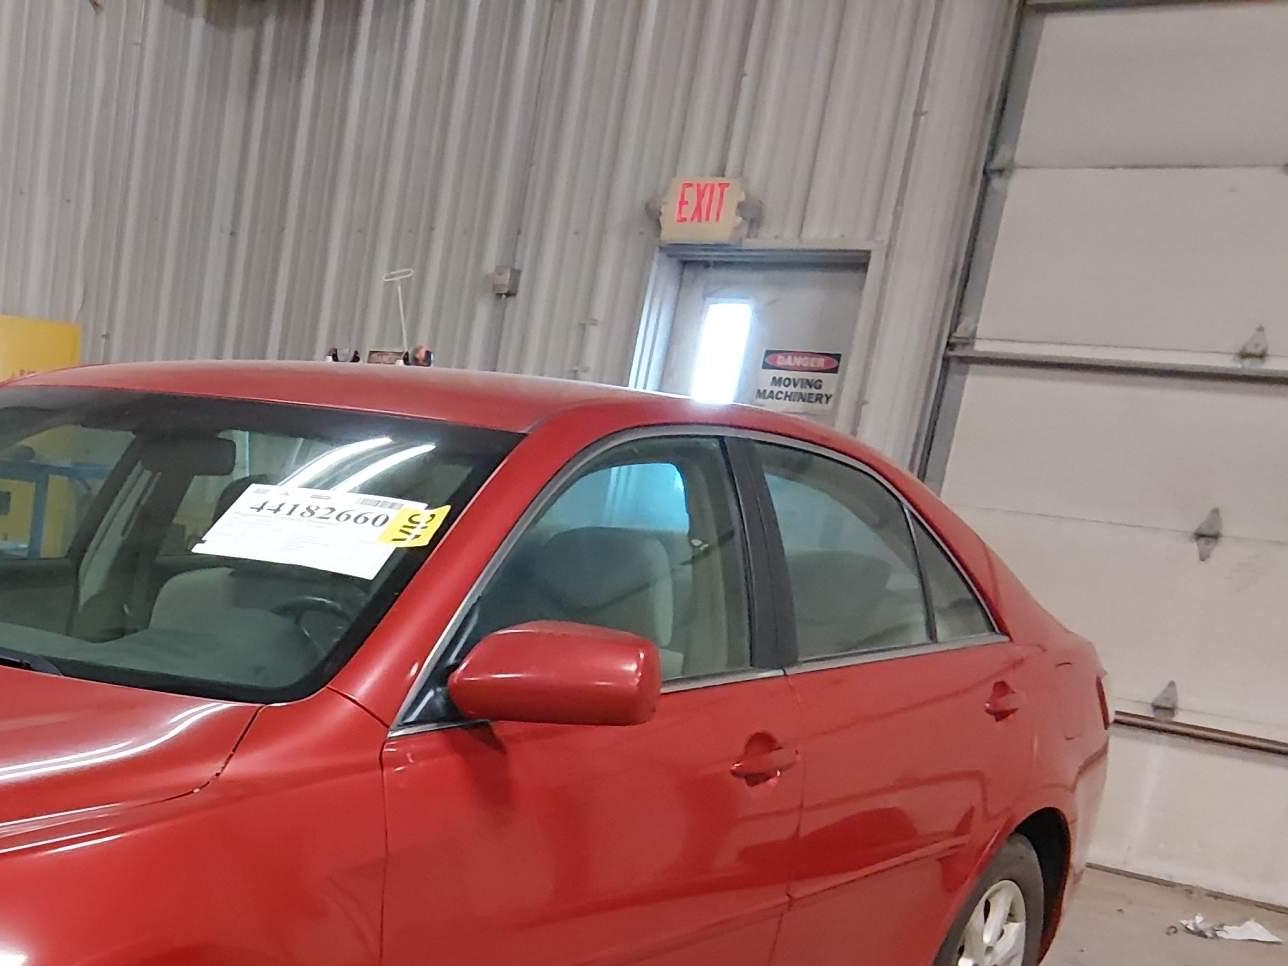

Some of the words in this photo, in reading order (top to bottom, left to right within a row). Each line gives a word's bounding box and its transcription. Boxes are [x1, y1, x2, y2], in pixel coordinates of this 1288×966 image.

[675, 182, 730, 223] EXIT
[776, 355, 825, 368] DANGER
[770, 376, 823, 390] MOVING
[755, 389, 833, 404] MACHINERY
[249, 500, 390, 528] 44182660
